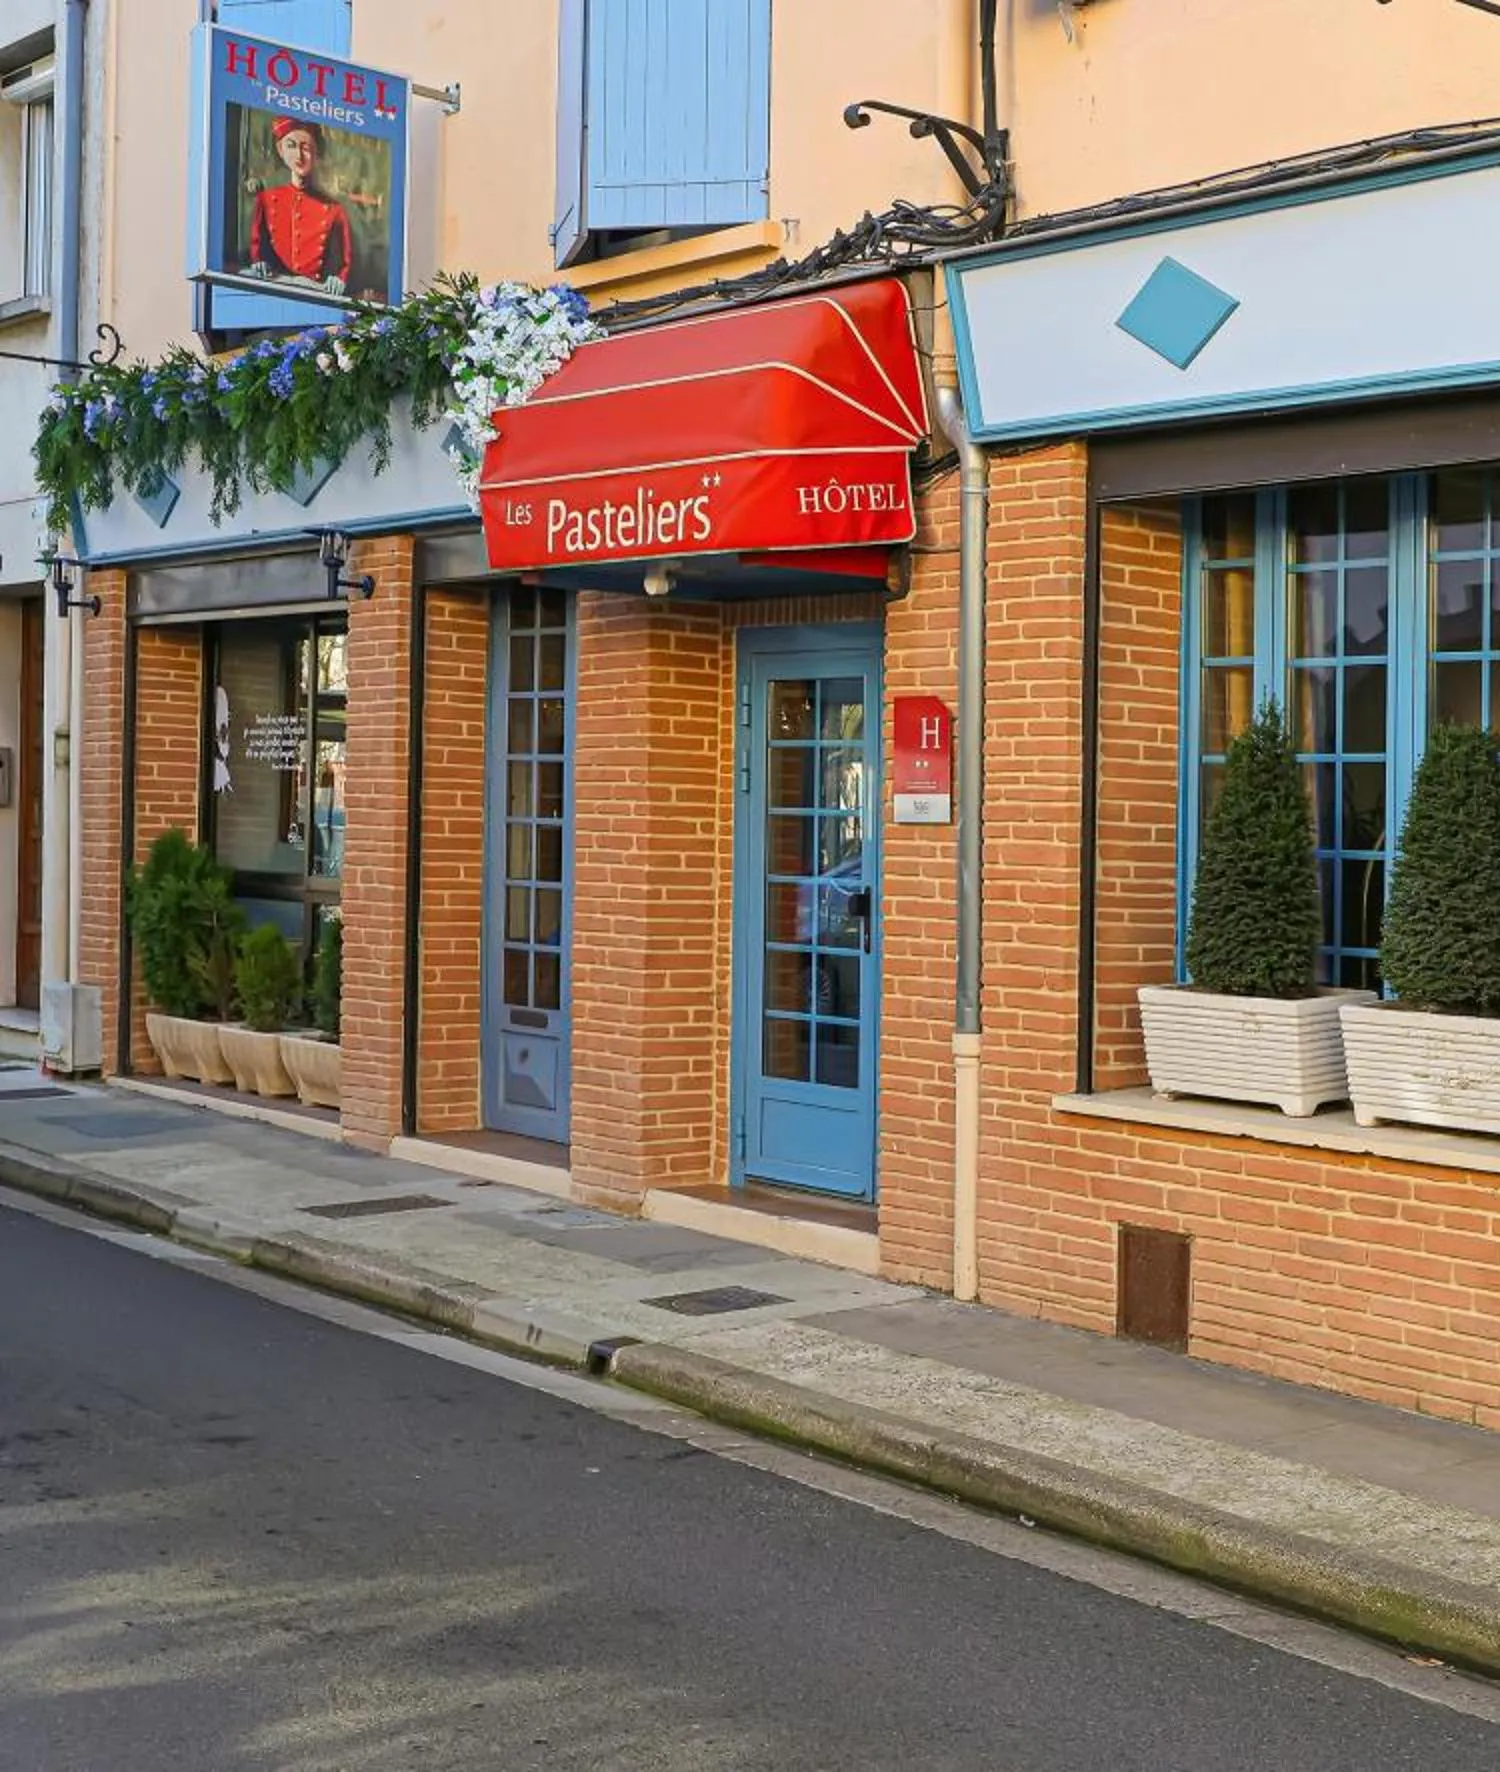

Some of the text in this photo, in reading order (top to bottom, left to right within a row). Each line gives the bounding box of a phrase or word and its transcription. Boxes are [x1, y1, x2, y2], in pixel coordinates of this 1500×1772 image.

[225, 41, 398, 113] HÔTEL
[265, 84, 366, 127] Pasteliers
[796, 478, 906, 514] HÔTEL
[506, 486, 711, 553] Les Pasteliers
[920, 717, 940, 749] H
